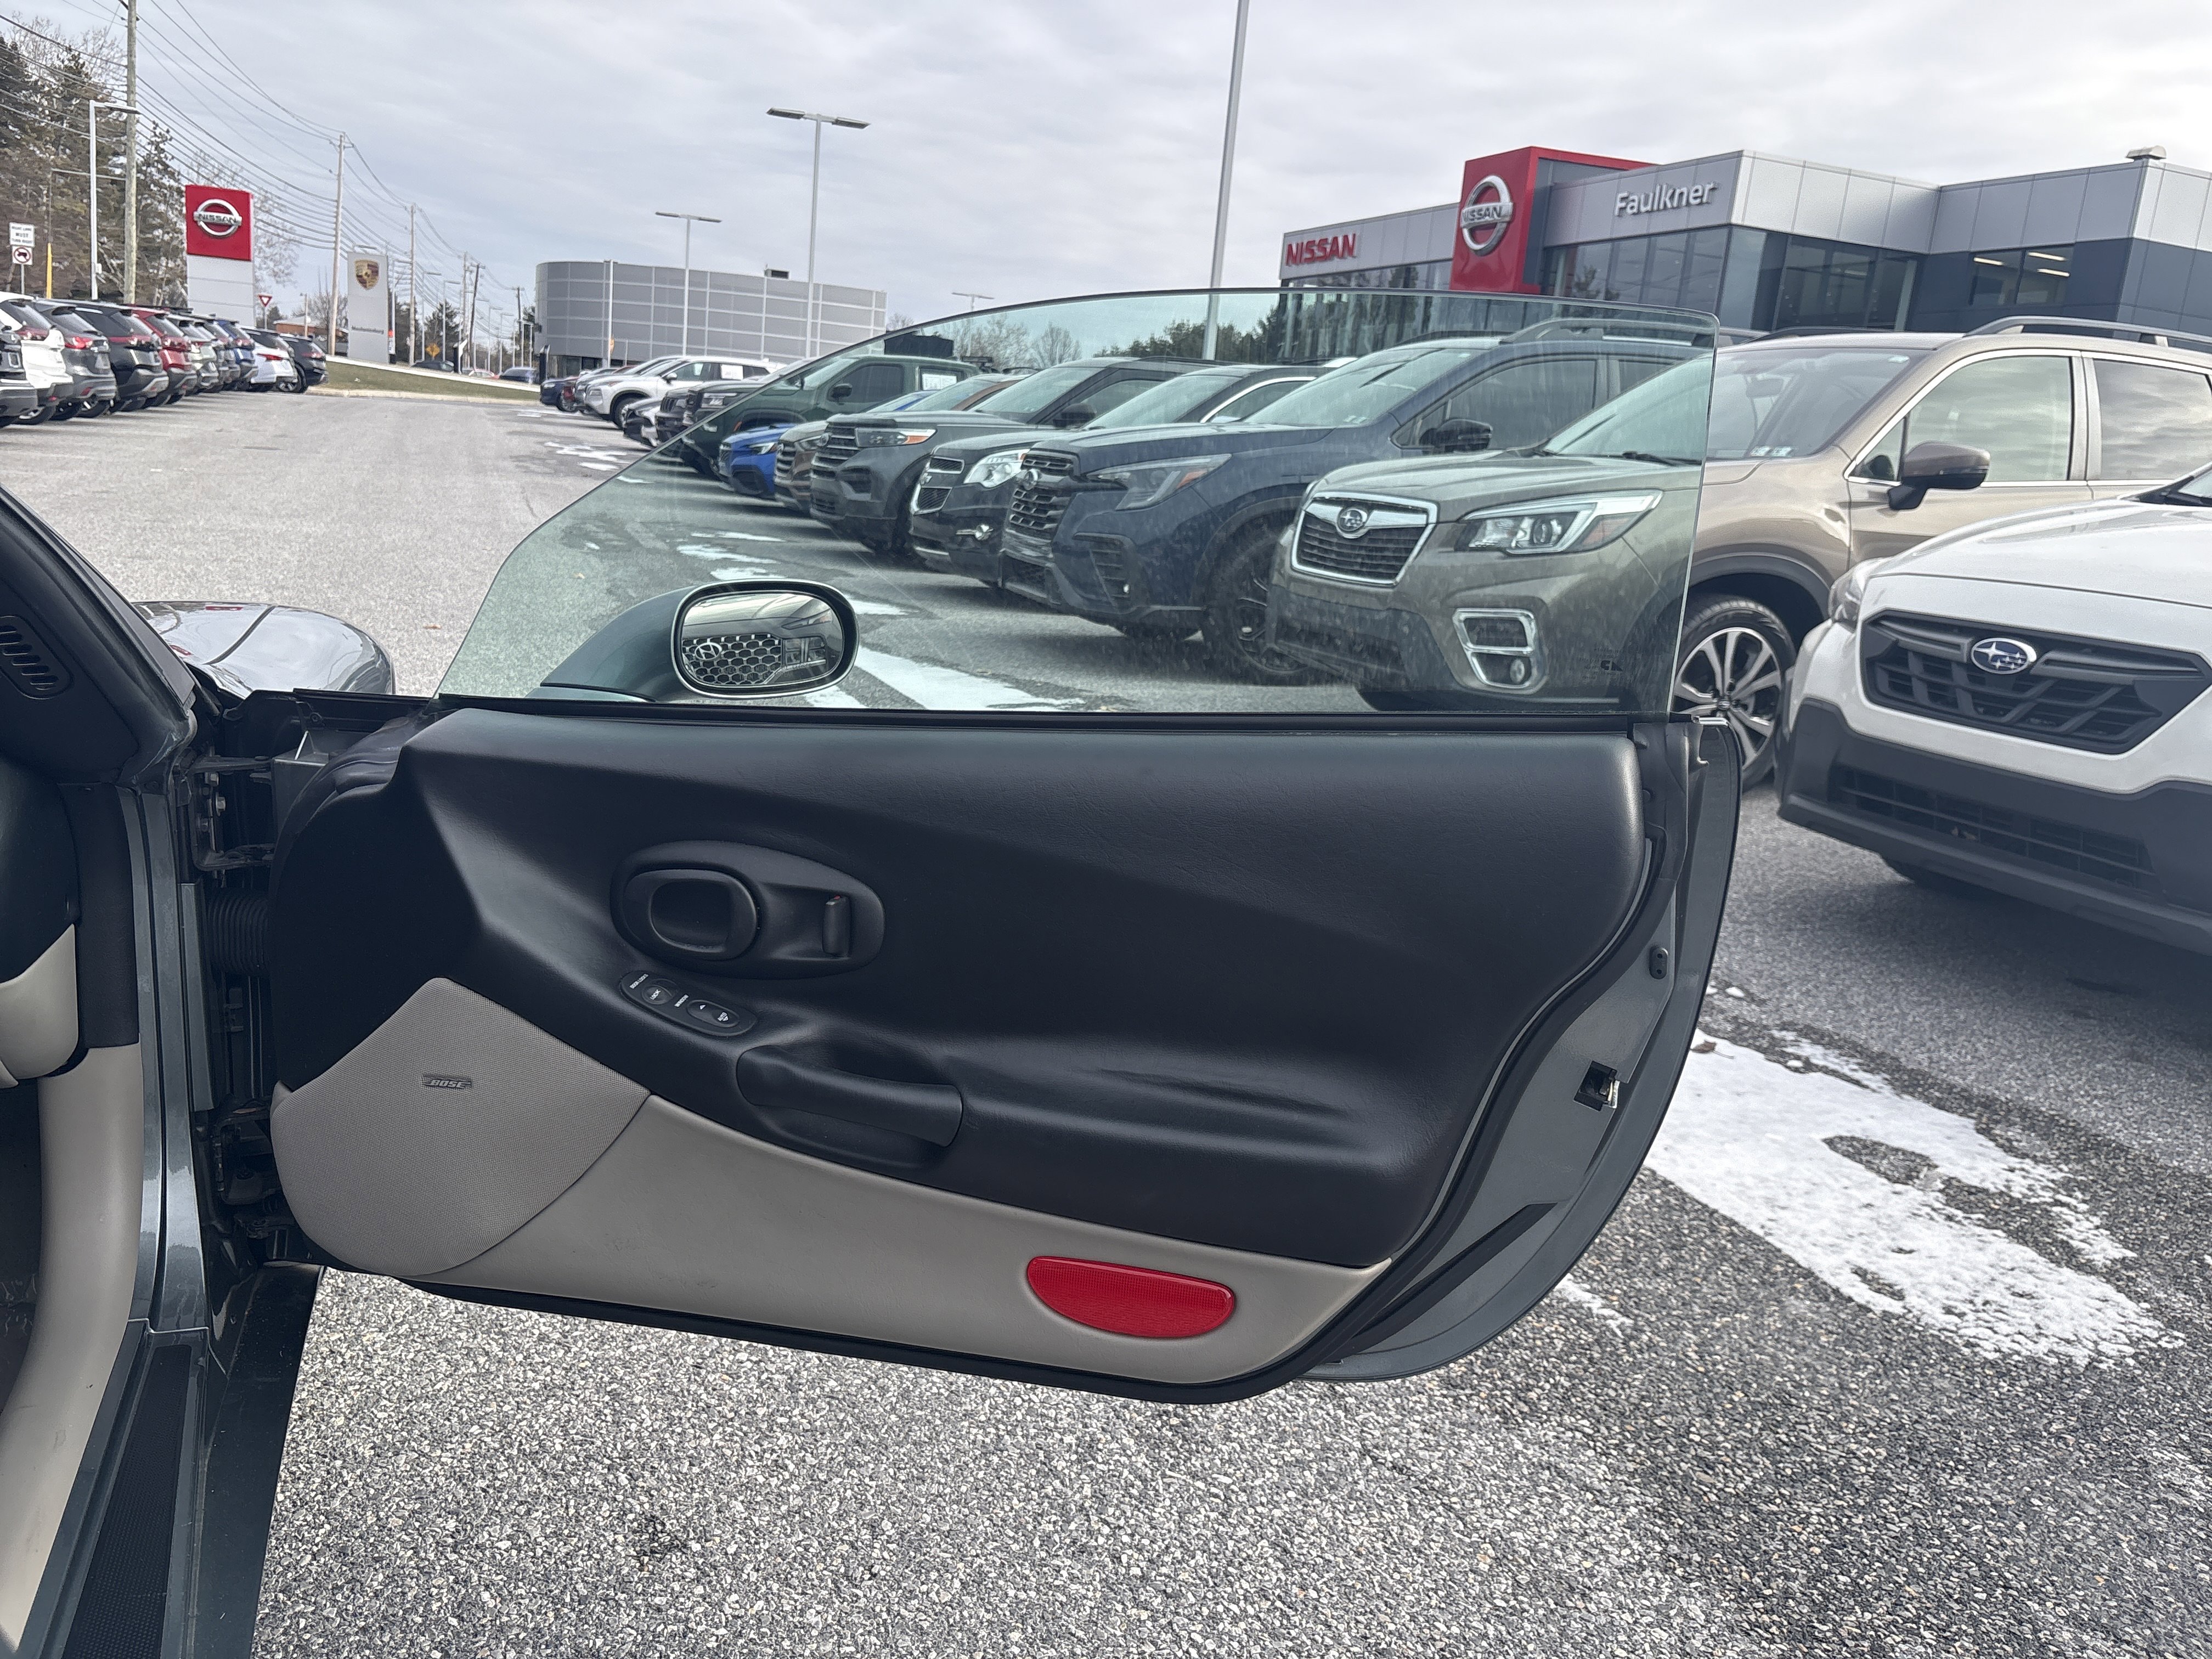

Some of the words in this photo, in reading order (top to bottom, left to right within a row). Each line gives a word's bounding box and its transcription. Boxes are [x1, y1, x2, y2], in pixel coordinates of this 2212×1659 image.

[1614, 181, 1718, 217] Faulkner
[198, 213, 237, 224] NISSAN
[1463, 205, 1503, 222] NISSAN
[1285, 233, 1357, 267] NISSAN
[637, 973, 649, 983] LOCKS
[650, 989, 661, 1000] LOCK
[717, 1012, 727, 1022] AUTO
[426, 1079, 471, 1089] BOSE
